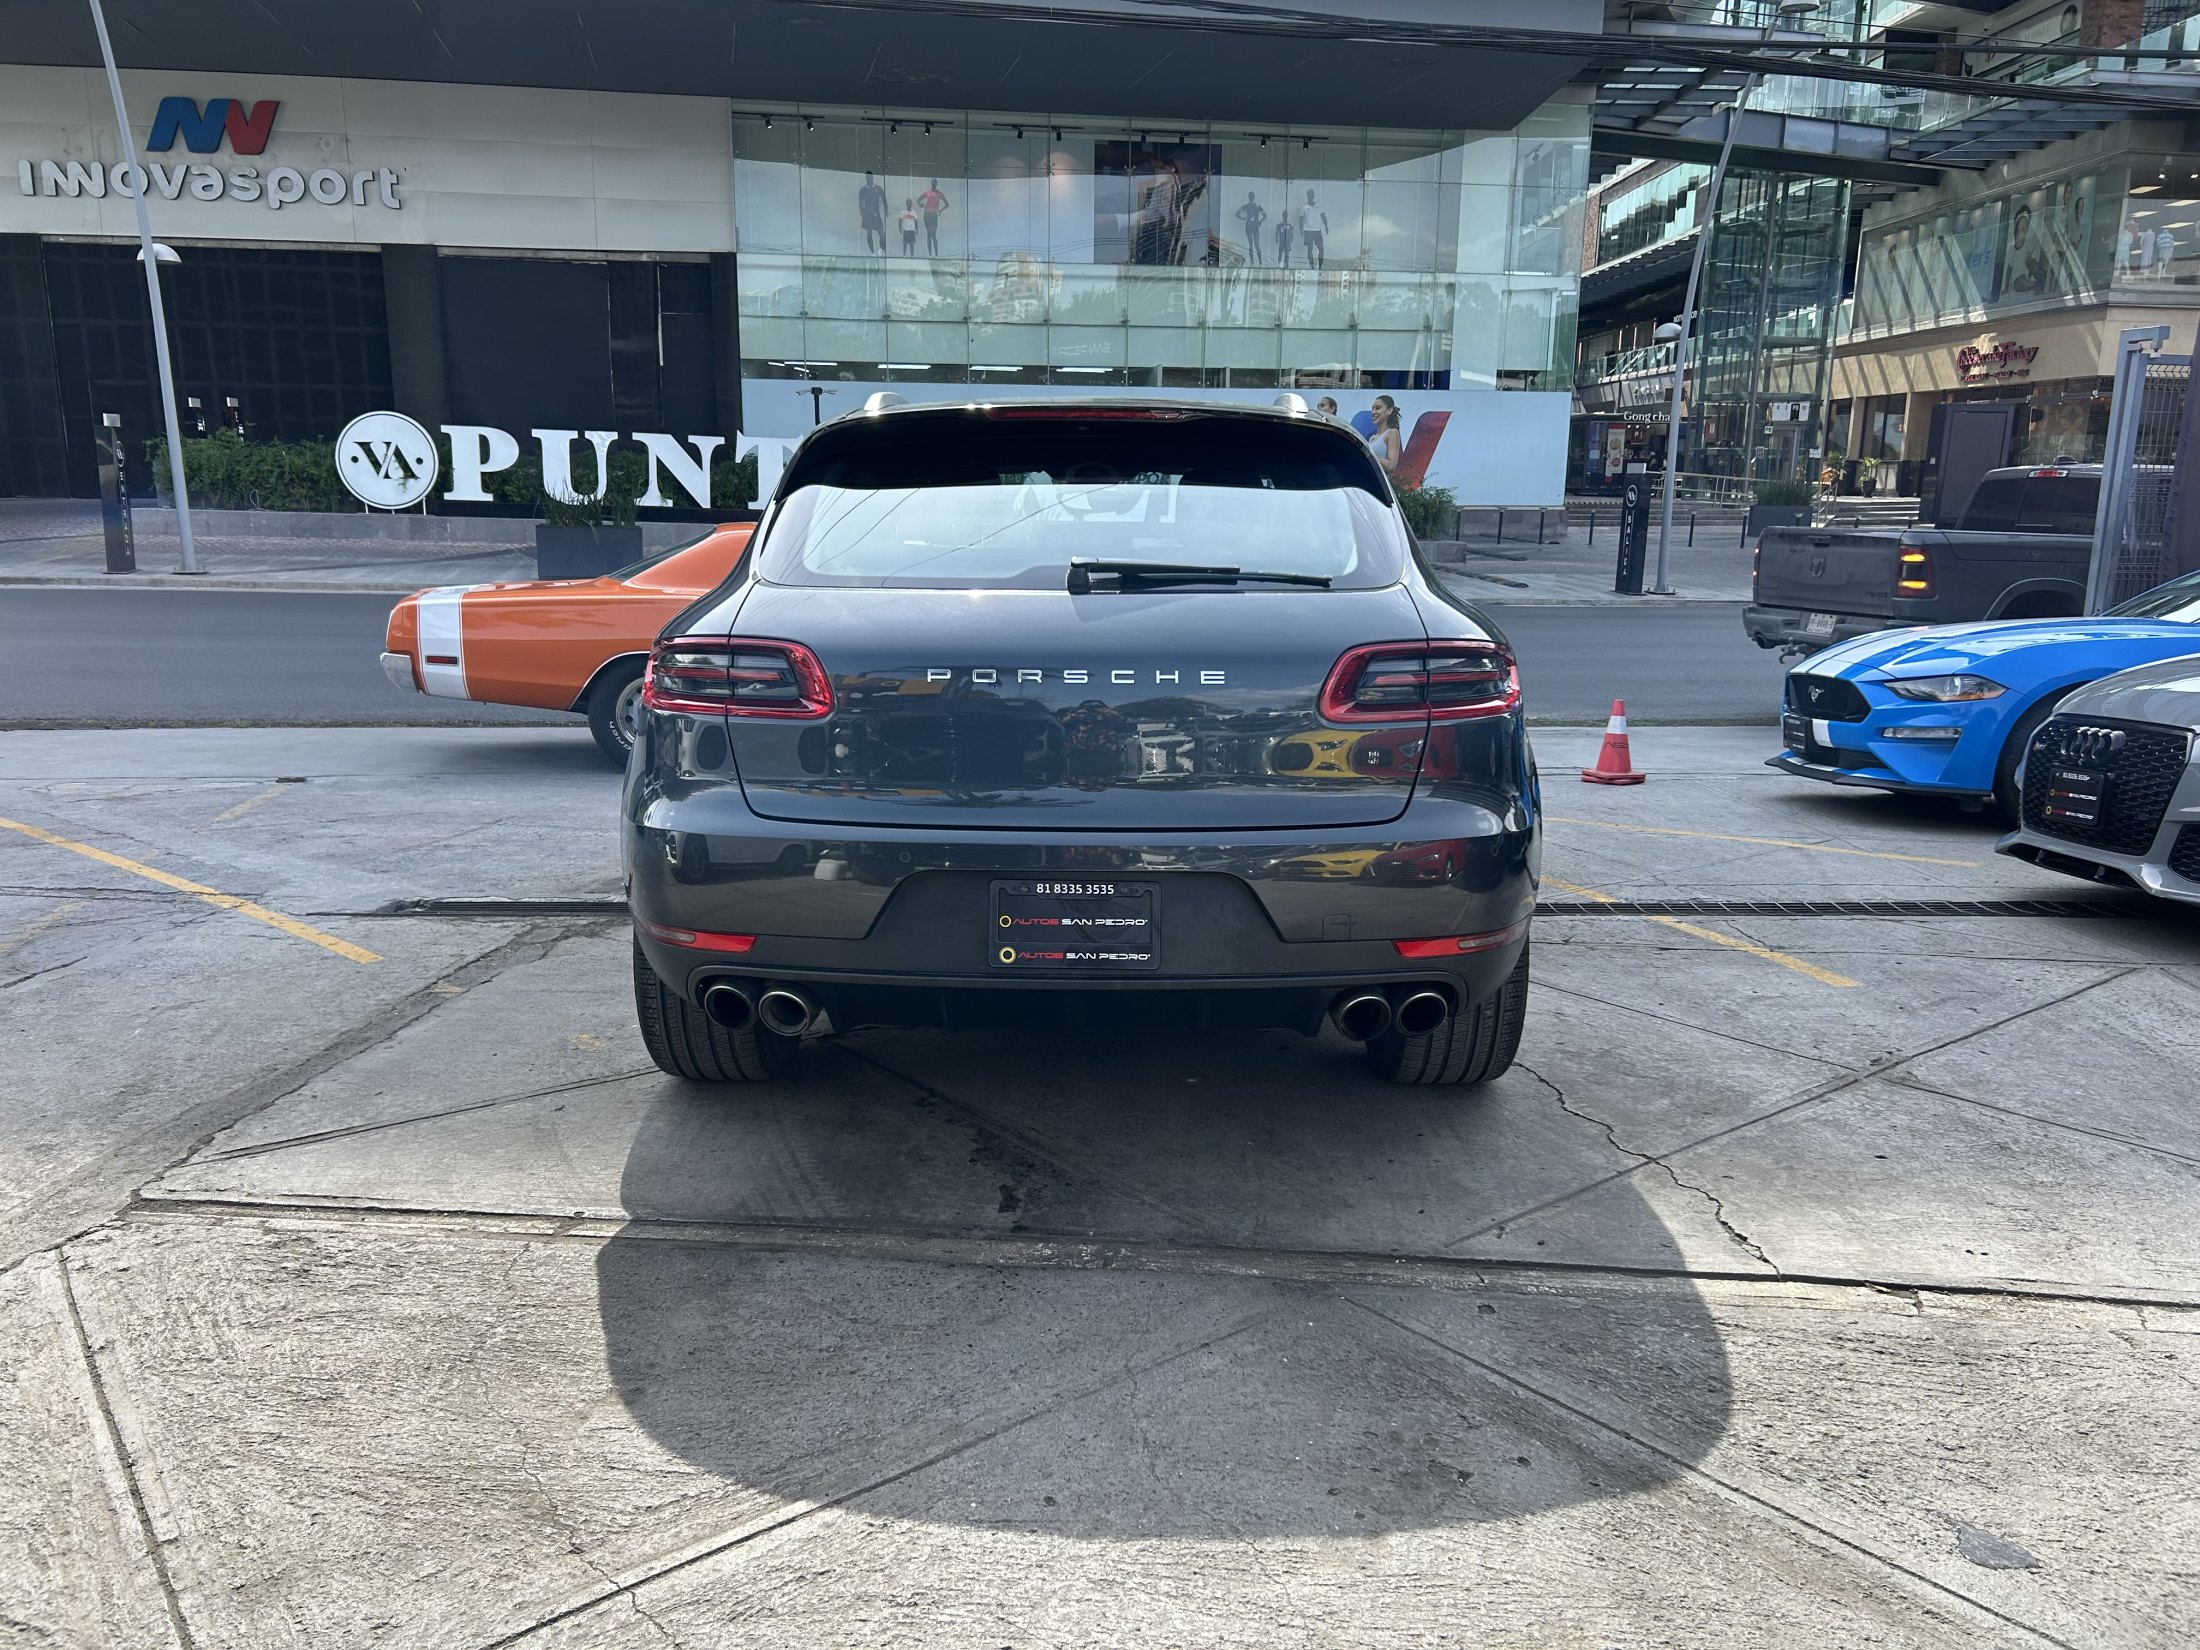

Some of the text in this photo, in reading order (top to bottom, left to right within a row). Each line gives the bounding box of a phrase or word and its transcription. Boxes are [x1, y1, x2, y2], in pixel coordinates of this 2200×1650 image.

[1623, 411, 1671, 424] Gong cha
[353, 441, 421, 480] VA
[926, 668, 1226, 685] PORSCHE
[1036, 884, 1115, 895] 81 8335 3535
[1012, 918, 1146, 926] AUTOS SAN PEDRO
[1018, 951, 1149, 961] AUTOS SAN PEDRO
